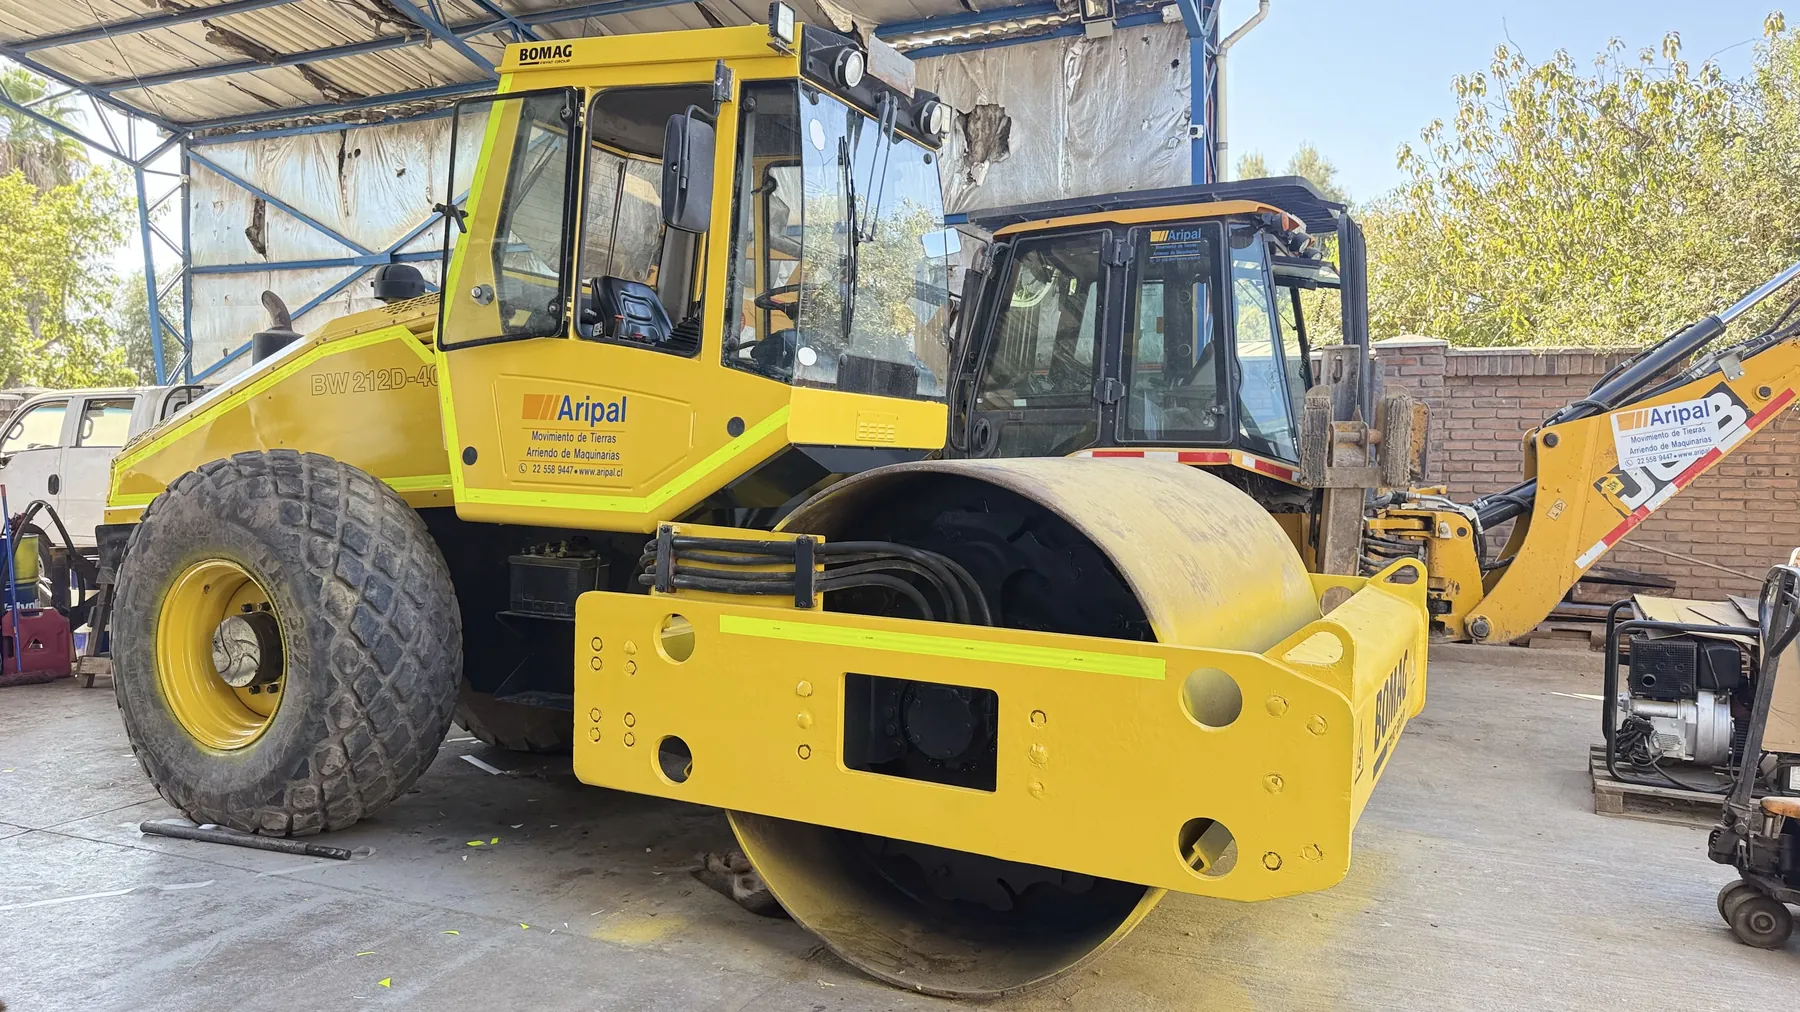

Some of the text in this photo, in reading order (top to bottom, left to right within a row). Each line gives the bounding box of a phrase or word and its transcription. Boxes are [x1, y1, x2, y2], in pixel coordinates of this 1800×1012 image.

[519, 45, 573, 61] BOMAG
[1168, 228, 1202, 241] Aripal
[311, 372, 350, 396] BW
[557, 395, 627, 427] Aripal
[1650, 400, 1710, 426] Aripal
[531, 431, 617, 444] Movimiento de Tierras
[1630, 431, 1670, 443] Movimiento
[1671, 430, 1681, 438] de
[1629, 445, 1658, 455] Arriendo
[1671, 436, 1713, 448] Maquinarias
[526, 447, 620, 461] Arriendo de Maquinarias
[1646, 456, 1657, 464] 558
[1658, 453, 1673, 461] 9447
[1677, 447, 1711, 458] www.aripal
[532, 464, 624, 478] 22 558 9447 www.aripal.cl
[1374, 649, 1408, 754] BOMAG
